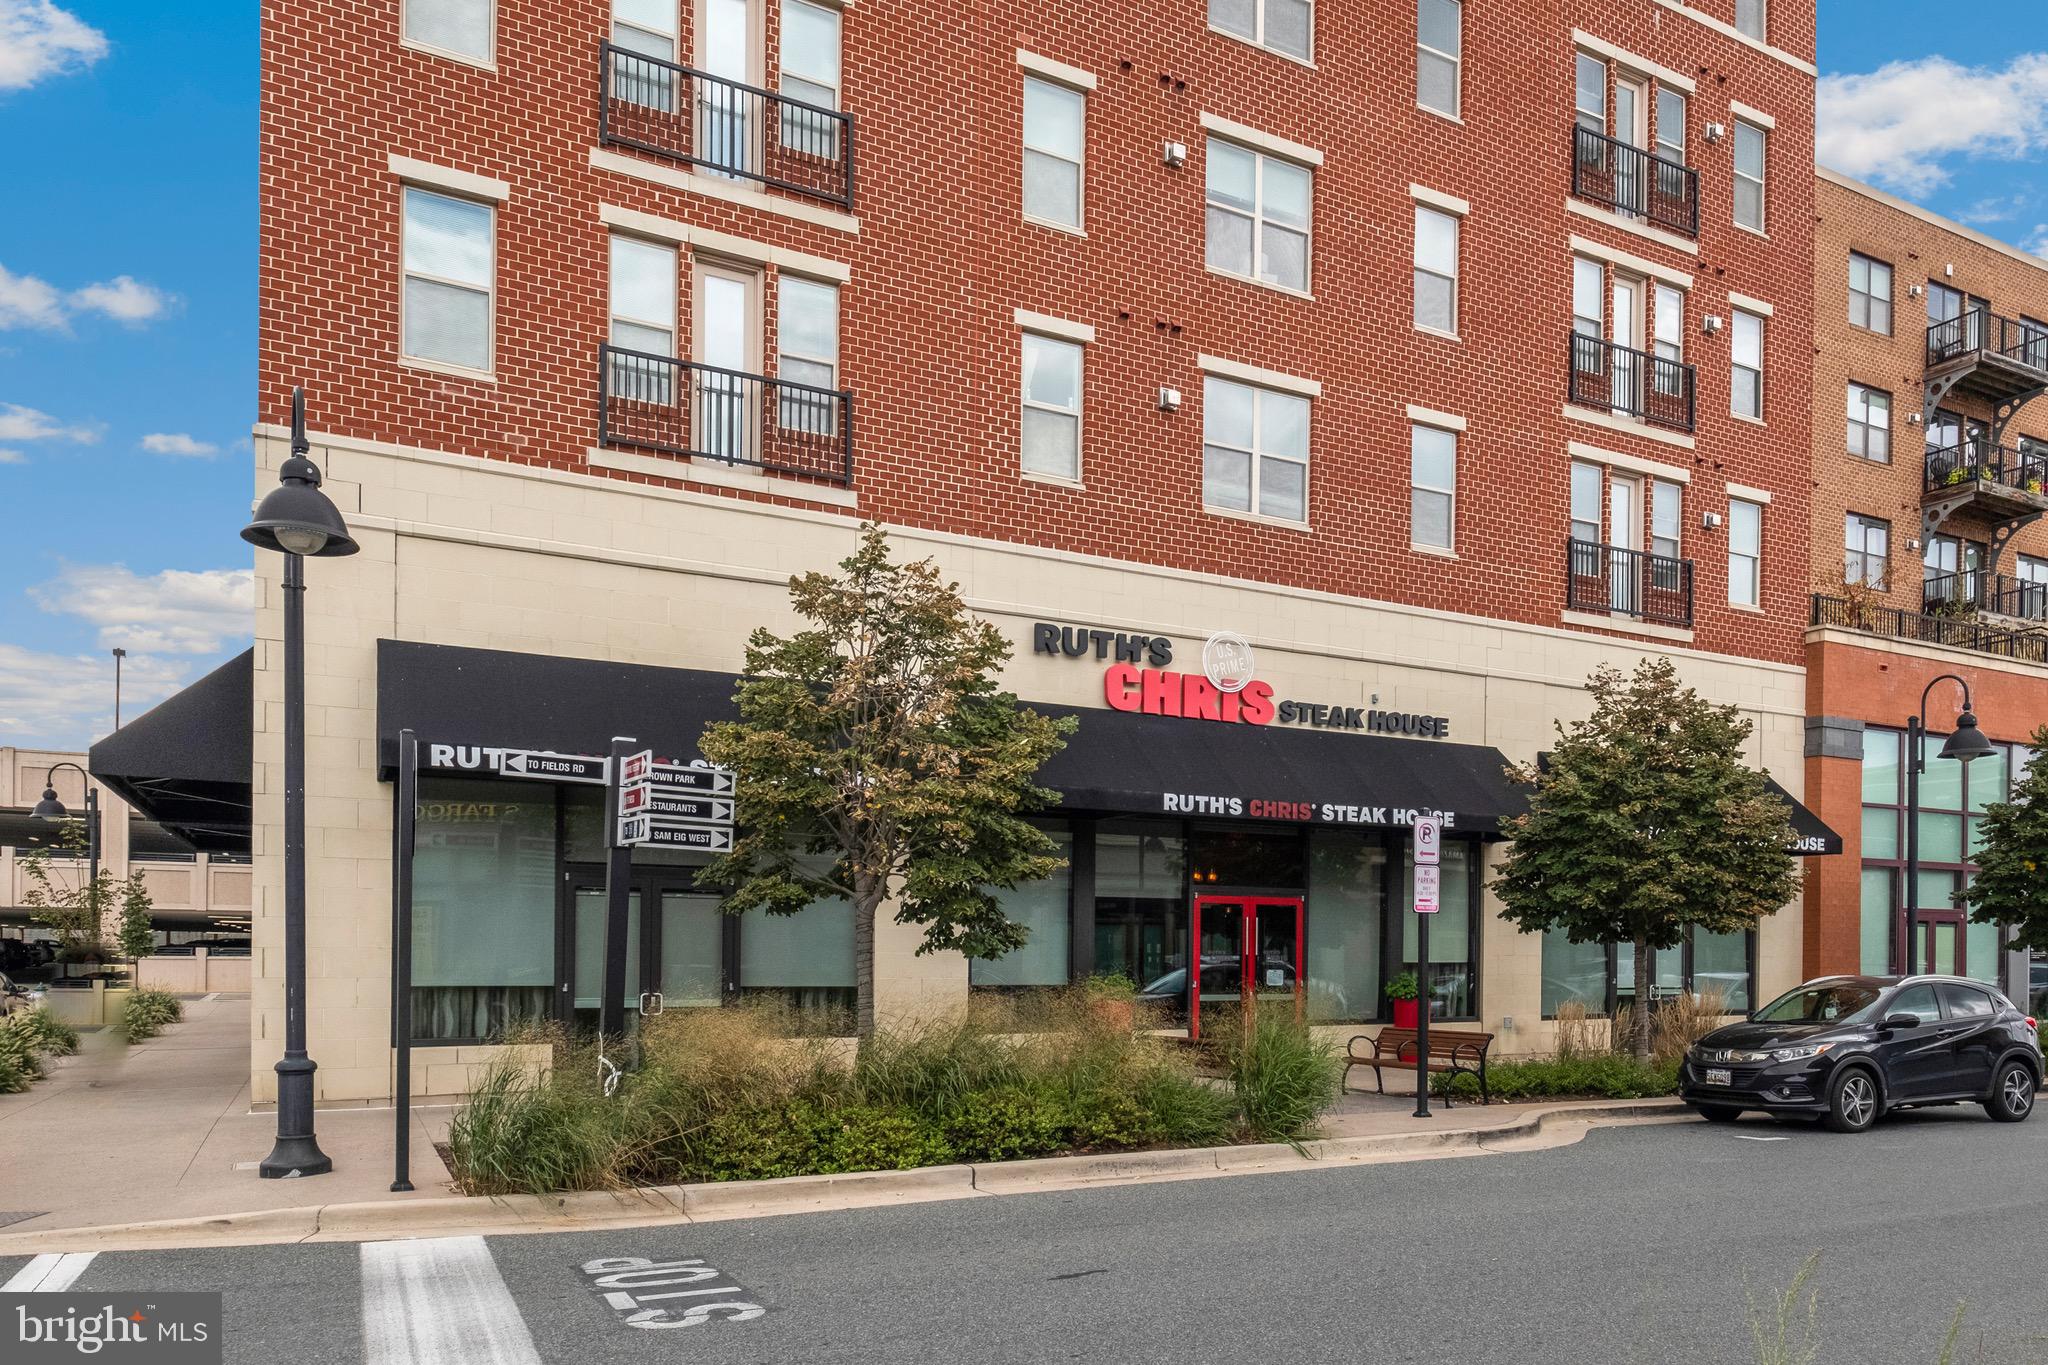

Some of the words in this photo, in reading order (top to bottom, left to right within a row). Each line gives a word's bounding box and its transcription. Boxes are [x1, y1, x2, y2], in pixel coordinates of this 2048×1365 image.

[1034, 623, 1173, 666] RUTH'S
[1216, 643, 1236, 658] U.S.
[1212, 657, 1246, 678] PRIME
[1104, 662, 1275, 725] CHRIS
[1279, 700, 1365, 729] STEAK
[1368, 709, 1449, 737] HOUSE
[528, 760, 539, 769] TO
[541, 761, 570, 772] FIELDS
[572, 764, 585, 773] RD
[649, 772, 673, 783] ROWN
[675, 774, 695, 784] PARK
[1163, 792, 1243, 816] RUTH'S
[1322, 803, 1386, 824] STEAK
[1393, 808, 1455, 827] HOSE
[654, 831, 671, 840] SAM
[673, 832, 687, 841] EIG
[689, 834, 710, 843] WEST
[1417, 876, 1437, 885] PARKING
[580, 1257, 766, 1329] STOP
